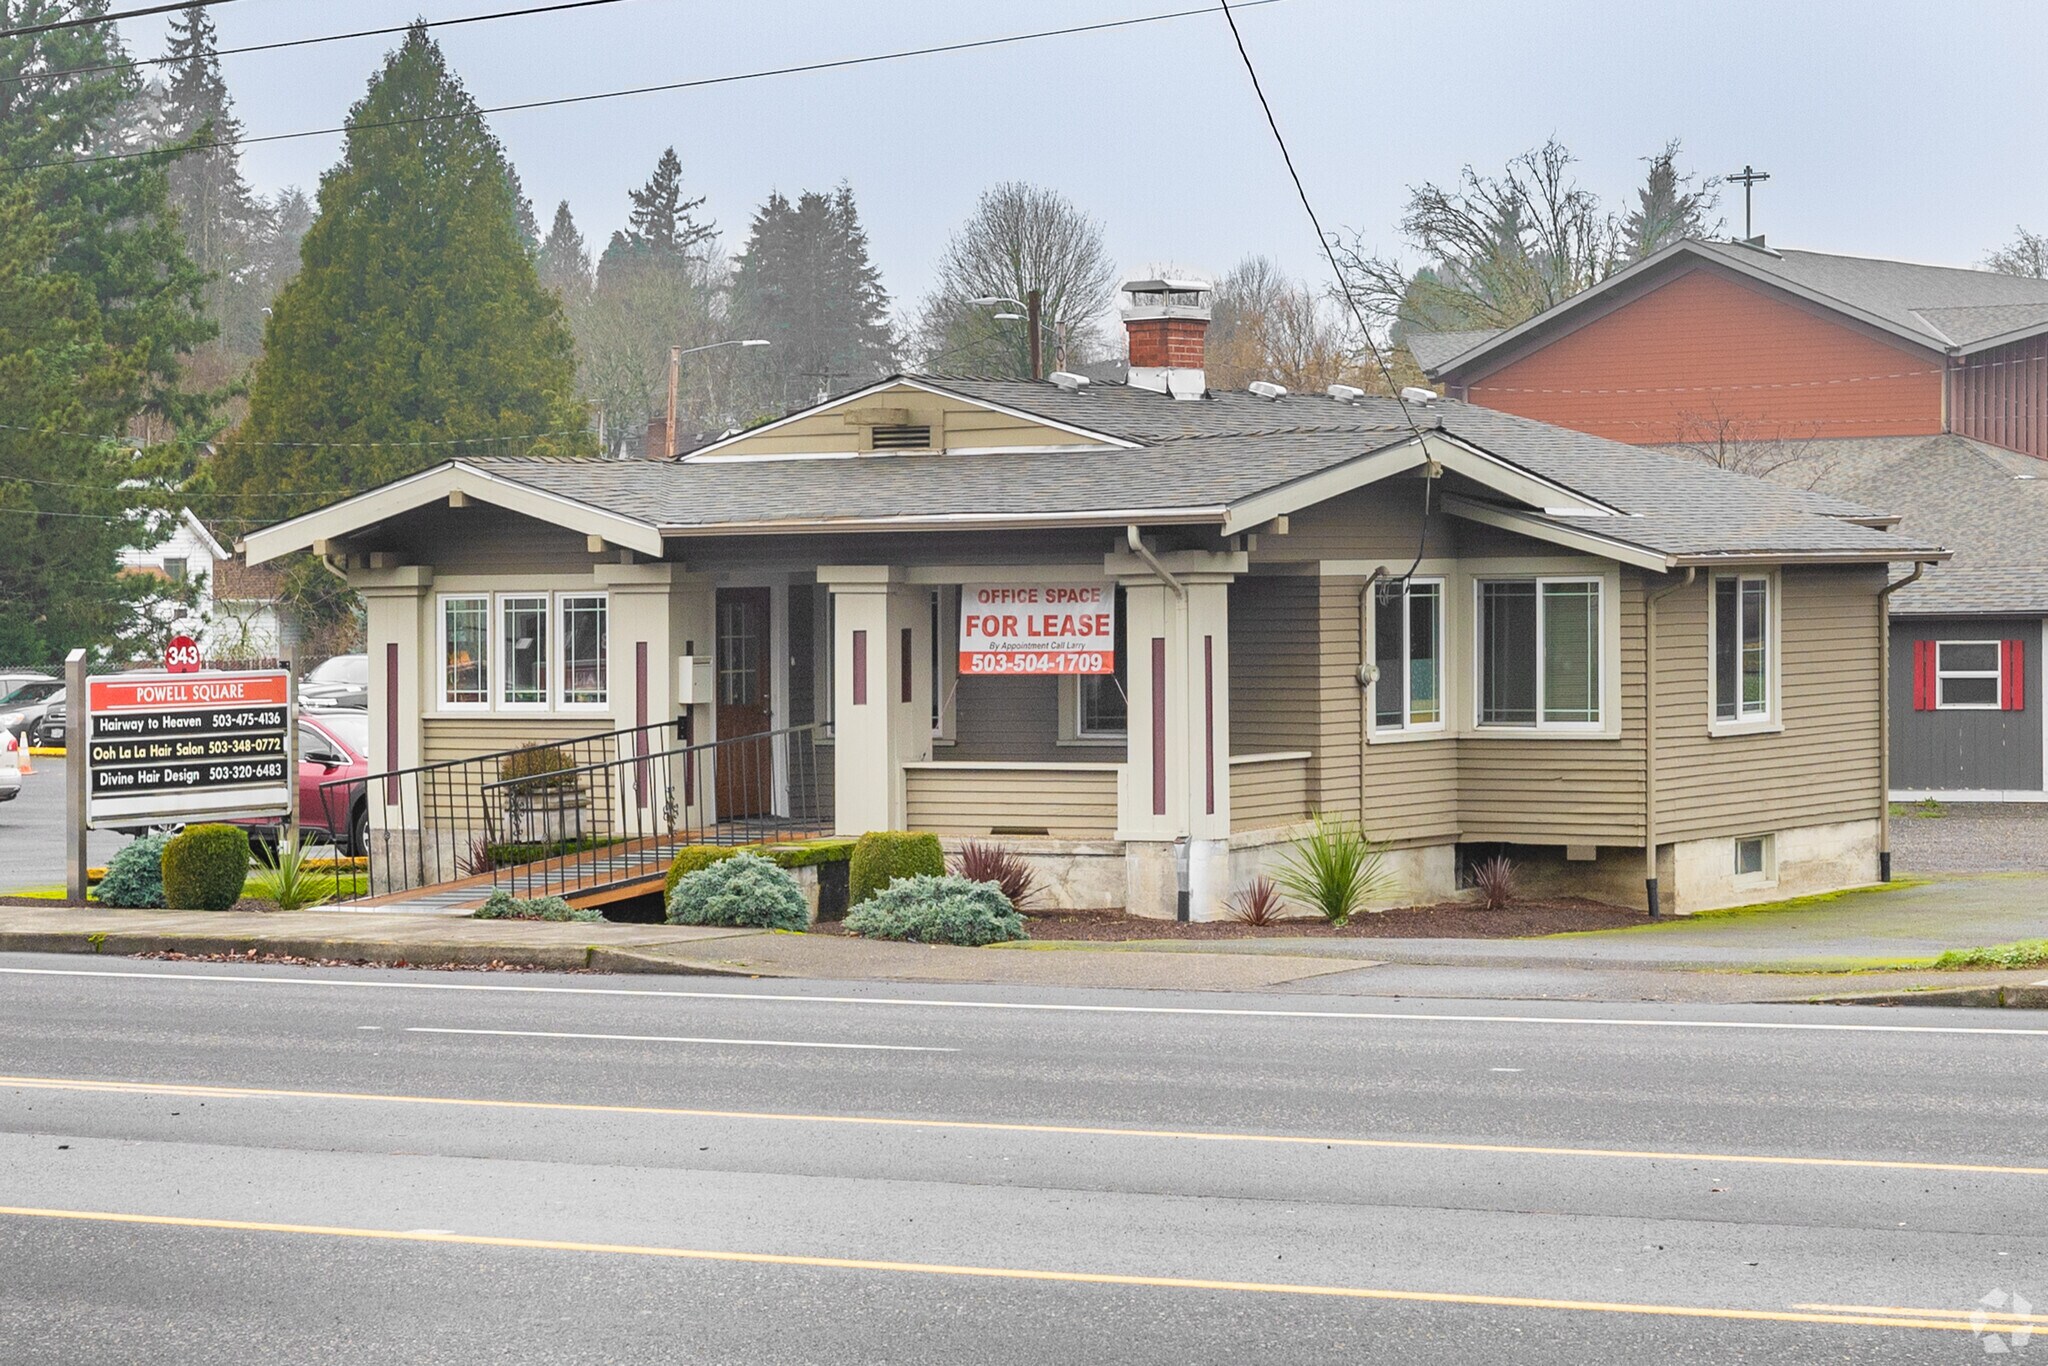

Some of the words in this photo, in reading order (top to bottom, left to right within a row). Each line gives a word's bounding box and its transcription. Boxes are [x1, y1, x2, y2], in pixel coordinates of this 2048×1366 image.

[978, 588, 1038, 604] OFFICE
[1045, 588, 1101, 603] SPACE
[966, 615, 1018, 637] FOR
[1027, 614, 1110, 637] LEASE
[989, 641, 1000, 650] By
[1001, 641, 1049, 650] Appointment
[1051, 641, 1066, 649] Call
[1066, 641, 1086, 650] Larry
[168, 646, 198, 665] 343
[971, 653, 1103, 672] 503-504-1709
[136, 685, 188, 702] POWELL
[192, 683, 244, 700] SQUARE
[100, 718, 144, 733] Hairway
[148, 718, 159, 729] to
[162, 715, 202, 728] Heaven
[212, 712, 281, 727] 503-475-4136
[93, 746, 116, 760] Ooh
[119, 746, 131, 759] La
[134, 745, 146, 758] La
[150, 744, 172, 757] Hair
[176, 743, 204, 756] Salon
[208, 738, 281, 754] 503-348-0772
[100, 772, 134, 786] Divine
[138, 770, 160, 783] Hair
[164, 769, 200, 783] Design
[209, 763, 281, 780] 503-320-6483
